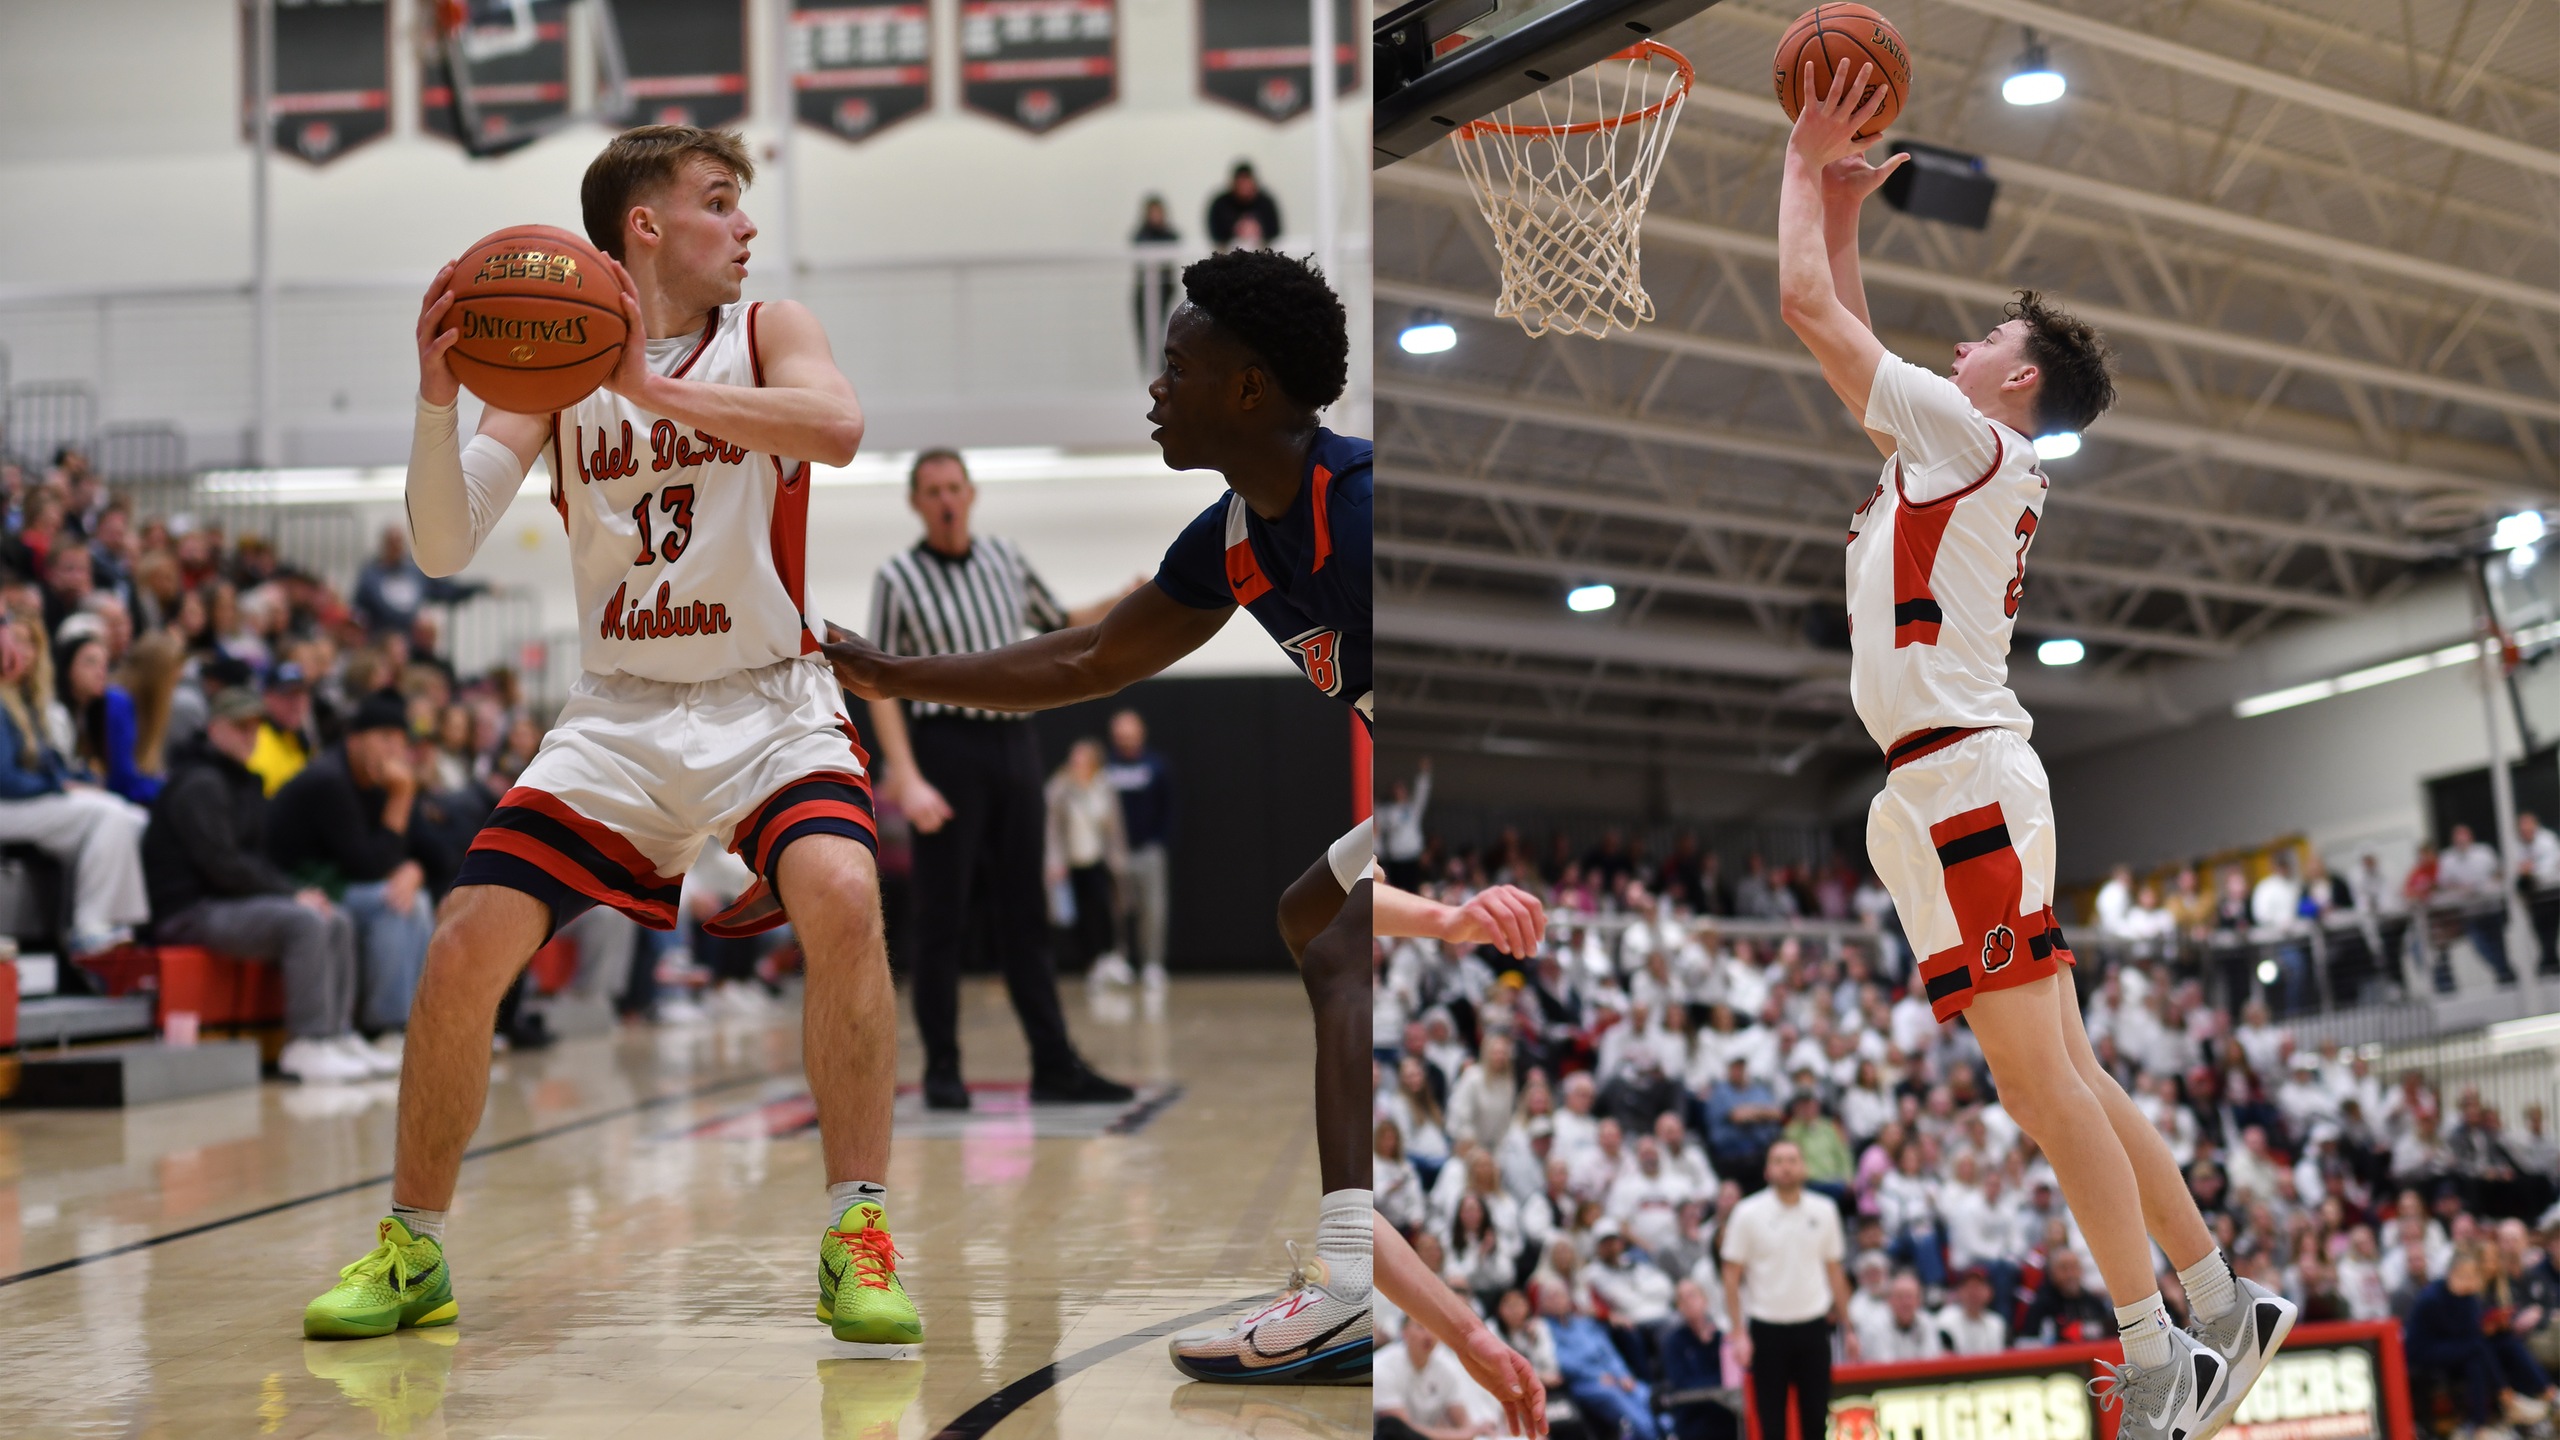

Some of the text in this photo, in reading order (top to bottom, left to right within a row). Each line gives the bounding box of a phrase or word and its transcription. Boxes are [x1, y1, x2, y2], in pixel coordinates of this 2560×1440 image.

[474, 262, 583, 290] LEGACY
[463, 309, 588, 345] SPALDING
[632, 483, 695, 566] 13
[600, 580, 732, 641] Minburn
[1872, 1373, 2092, 1440] TIGERS
[2233, 1347, 2374, 1425] GERS
